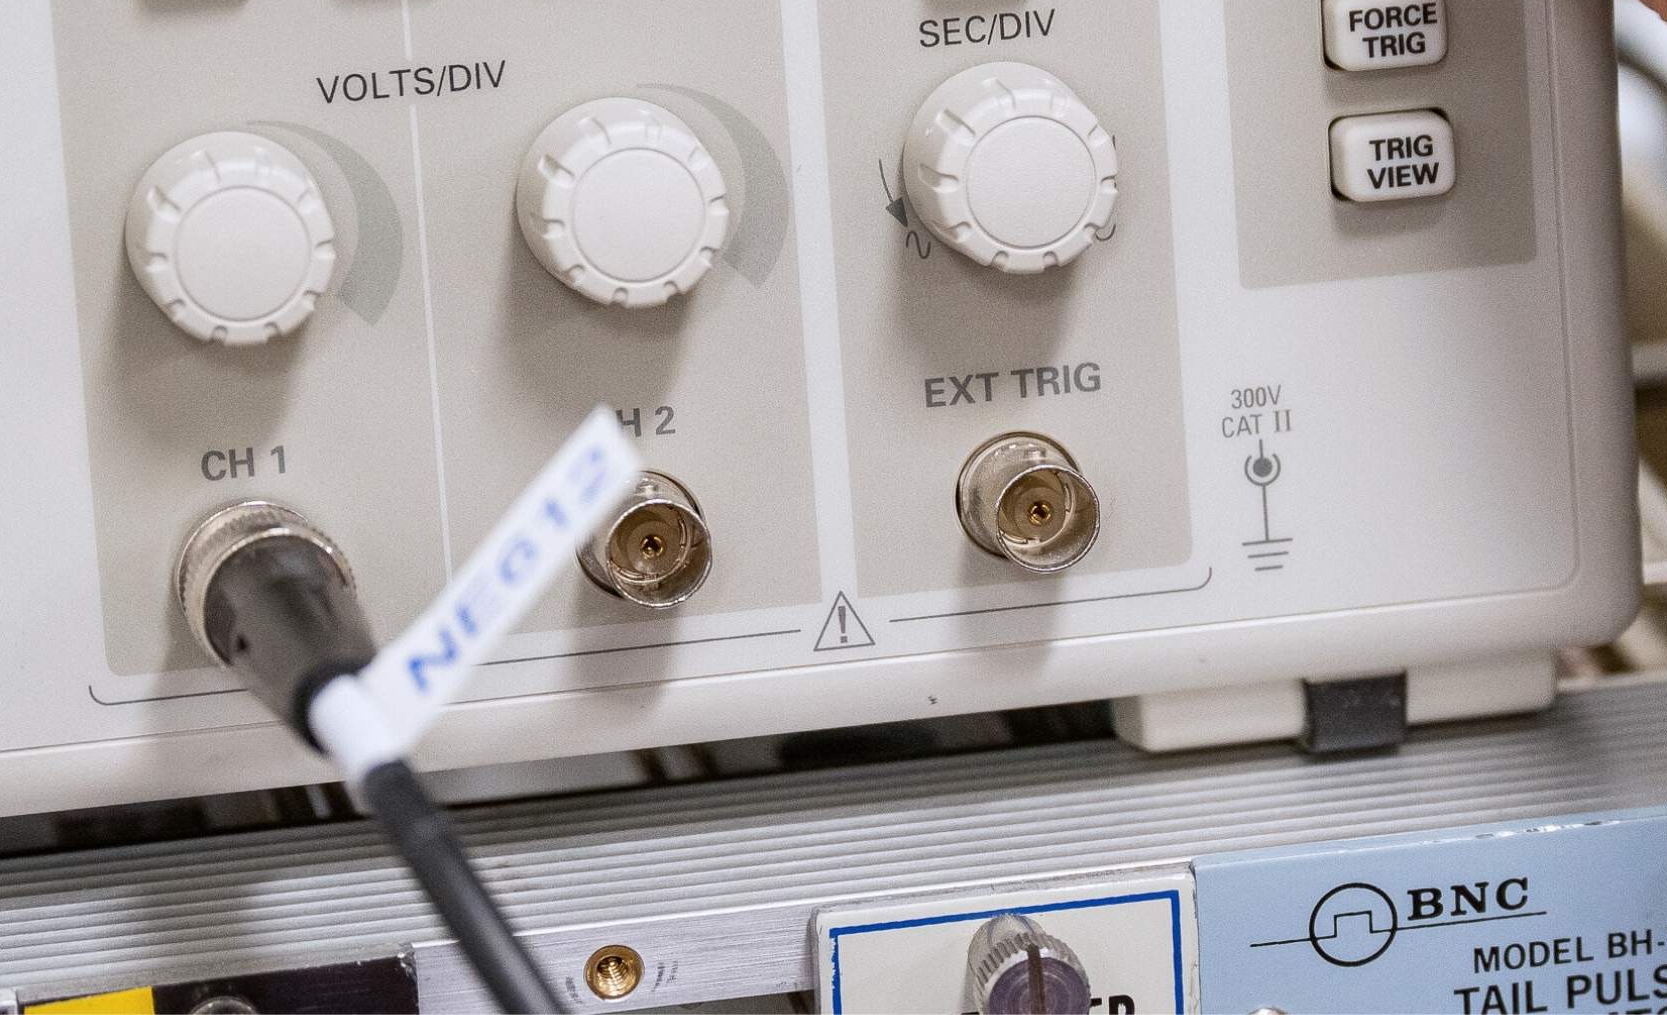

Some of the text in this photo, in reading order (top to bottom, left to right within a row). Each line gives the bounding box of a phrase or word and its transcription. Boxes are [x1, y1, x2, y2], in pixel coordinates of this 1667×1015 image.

[918, 7, 1057, 49] SEC/DIV
[1349, 2, 1439, 33] FORCE
[1362, 30, 1428, 58] TRIG
[315, 59, 508, 106] VOLTS/DIV
[1369, 135, 1435, 162] TRIG
[1367, 160, 1440, 191] VIEW
[924, 360, 1104, 409] EXT TRIG
[1230, 384, 1282, 410] 300V
[654, 405, 677, 436] 2
[1221, 414, 1263, 439] CAT
[200, 442, 289, 482] CH 1
[1407, 877, 1531, 921] BNC
[1472, 938, 1595, 974] MODEL
[1453, 979, 1549, 1015] TAIL
